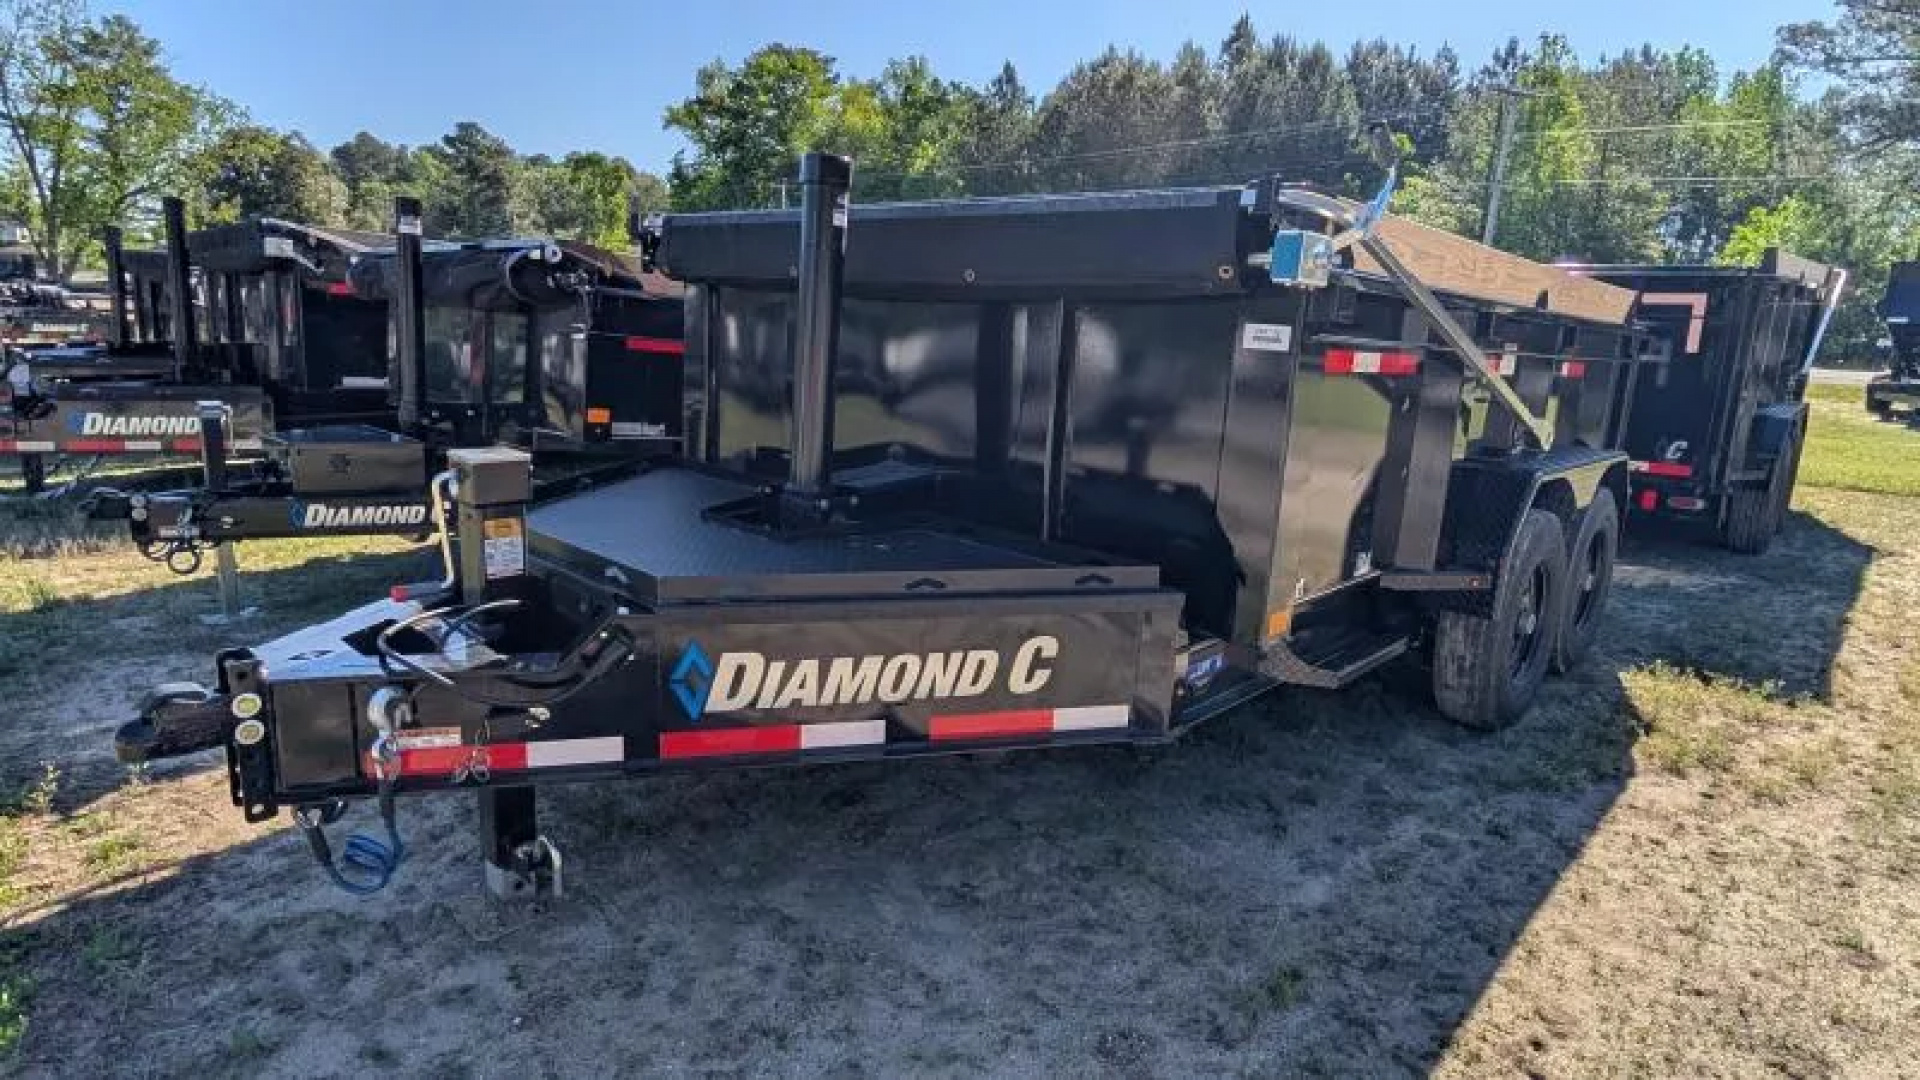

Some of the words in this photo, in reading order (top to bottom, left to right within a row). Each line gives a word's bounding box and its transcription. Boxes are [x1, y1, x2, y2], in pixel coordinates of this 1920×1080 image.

[83, 412, 200, 435] DIAMOND
[304, 503, 426, 527] DIAMOND
[704, 651, 999, 712] DIAMOND
[1007, 635, 1060, 695] C
